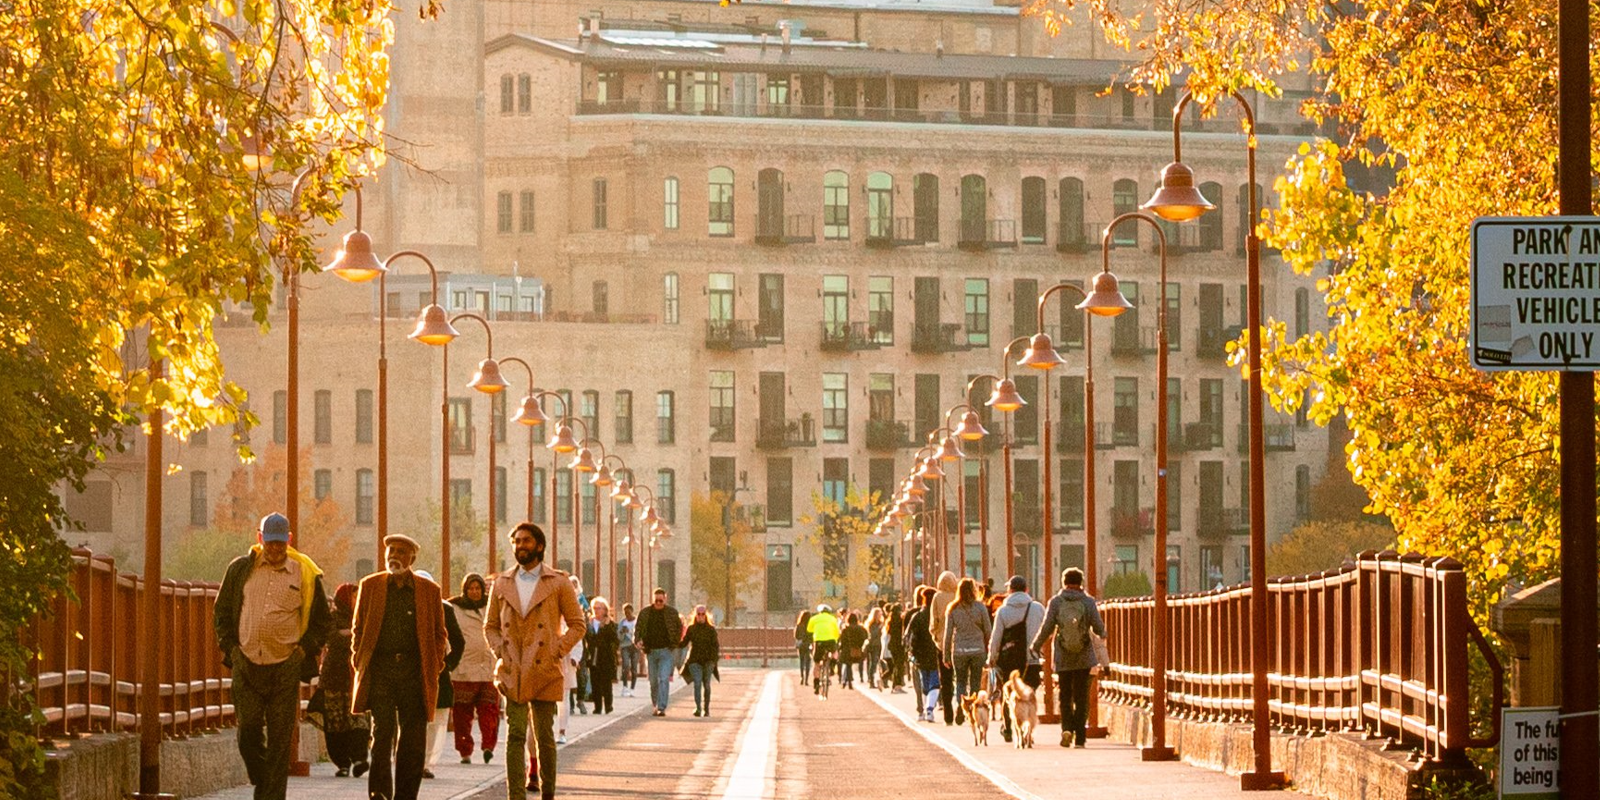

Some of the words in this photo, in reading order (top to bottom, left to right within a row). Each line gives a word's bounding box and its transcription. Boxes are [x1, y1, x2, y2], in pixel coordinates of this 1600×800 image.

[1513, 228, 1568, 255] PARK
[1503, 263, 1600, 289] RECREAT
[1516, 297, 1600, 324] VEHICLE
[1539, 332, 1594, 359] ONLY
[1515, 721, 1541, 739] The
[1514, 744, 1530, 762] of
[1533, 743, 1558, 761] this
[1513, 767, 1553, 788] being
